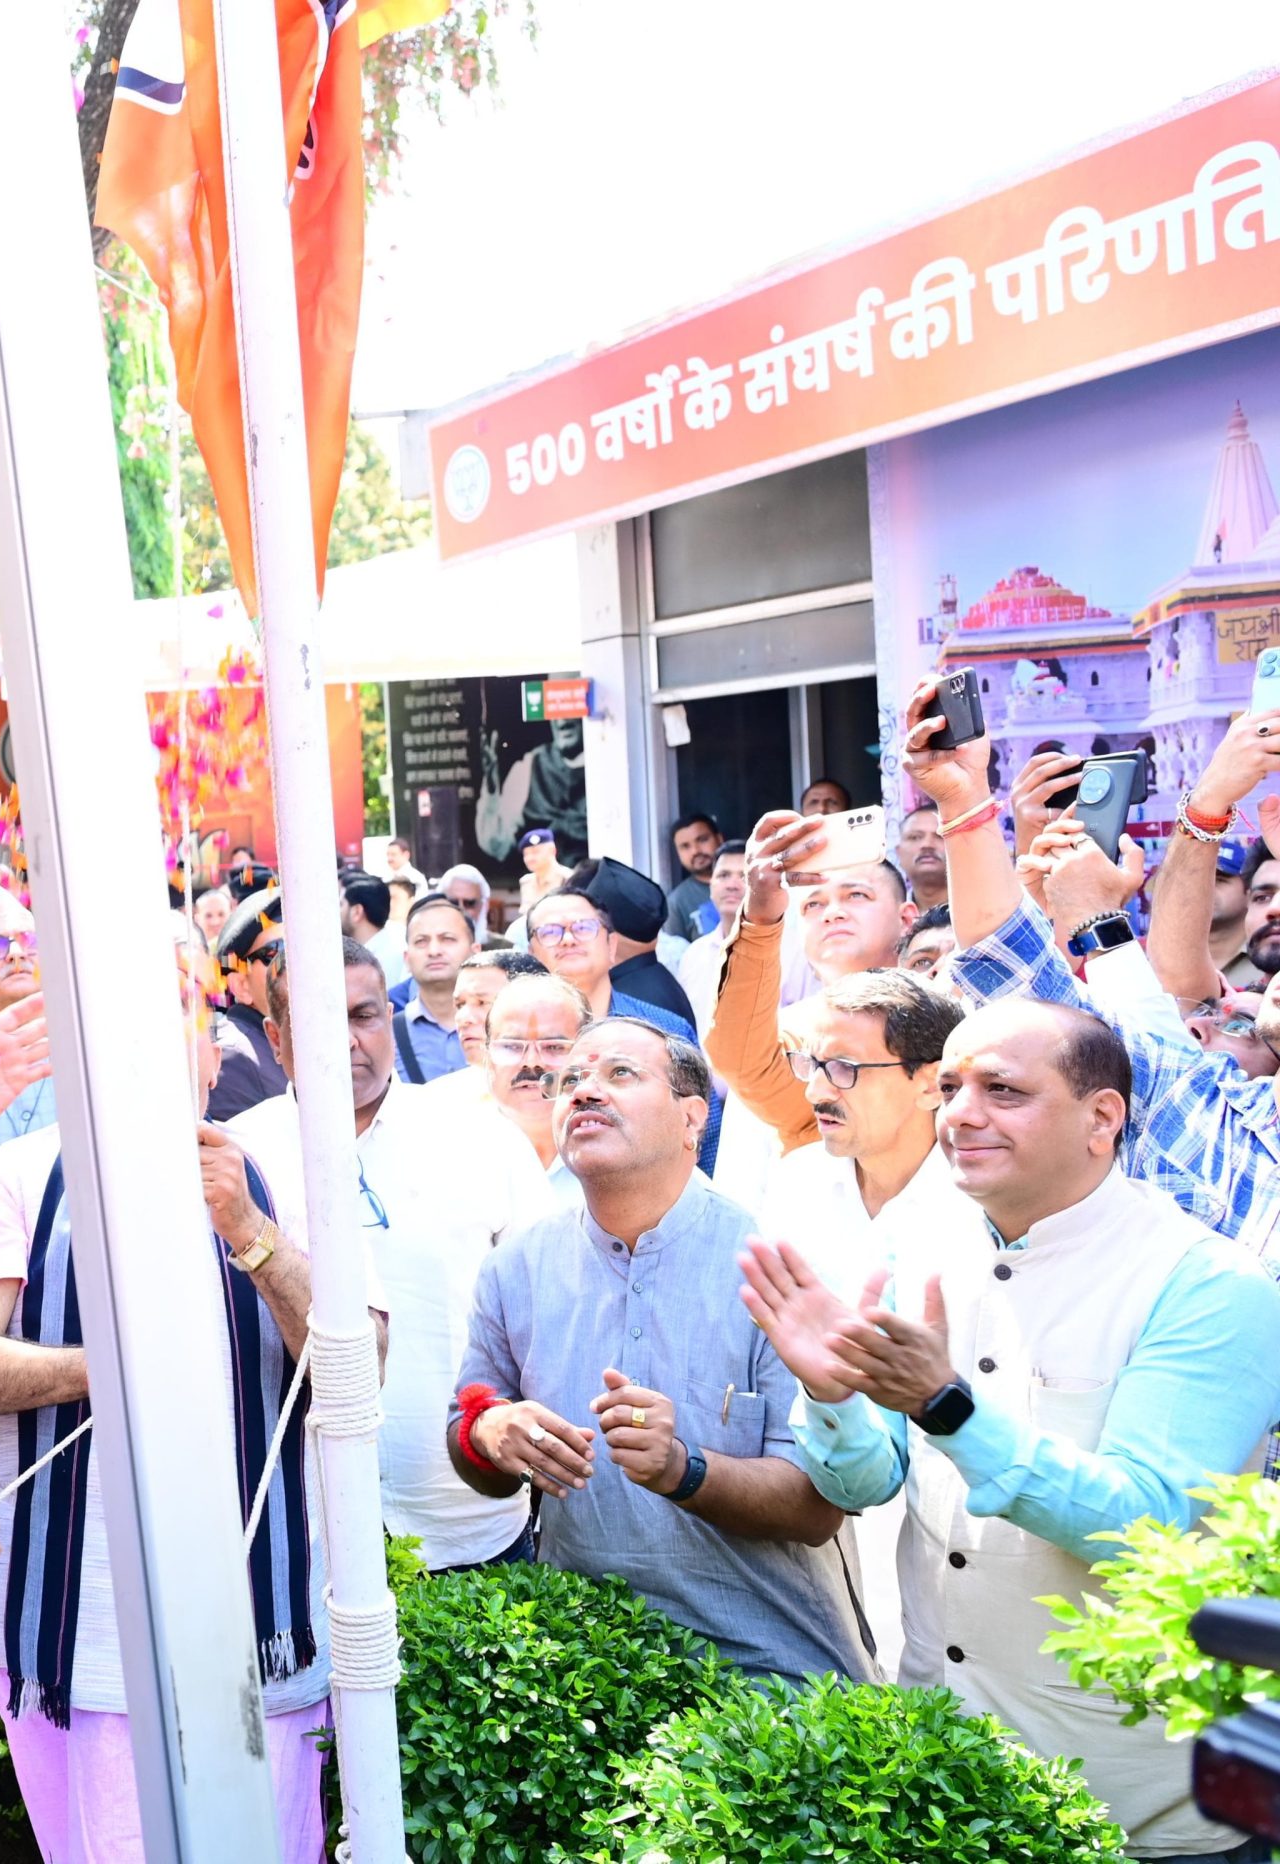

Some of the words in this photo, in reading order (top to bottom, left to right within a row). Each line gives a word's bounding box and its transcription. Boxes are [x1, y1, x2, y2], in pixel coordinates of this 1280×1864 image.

[506, 423, 586, 495] 500
[591, 364, 681, 462] वर्षों
[679, 357, 733, 430] के
[739, 287, 885, 414] संघर्ष
[884, 256, 975, 359] की
[986, 140, 1280, 324] परिणति
